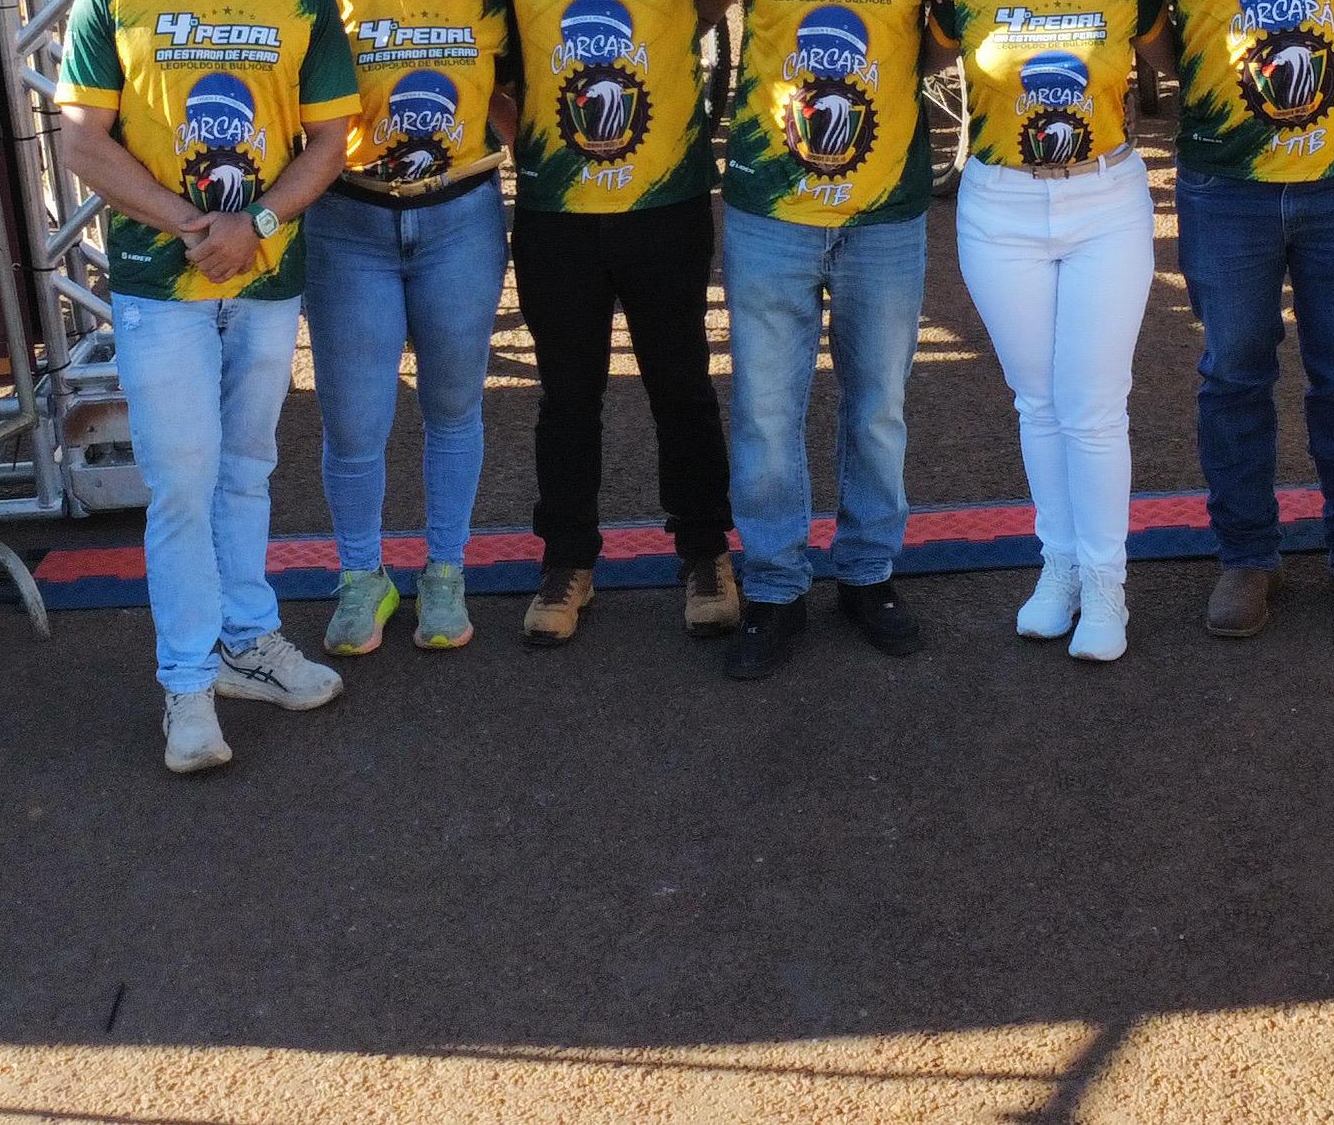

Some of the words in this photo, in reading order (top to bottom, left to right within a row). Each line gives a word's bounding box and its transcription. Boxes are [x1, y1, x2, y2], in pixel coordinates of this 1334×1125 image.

[1028, 14, 1107, 30] PEDAL
[195, 25, 281, 47] PEDAL
[395, 27, 475, 45] PEDAL
[161, 62, 214, 70] LEOPOLDO
[174, 50, 224, 60] ESTRADA
[225, 50, 239, 60] DE
[242, 51, 278, 62] FERRO
[363, 62, 415, 72] LEOPOLDO
[375, 50, 427, 61] ESTRADA
[429, 49, 442, 57] DE
[444, 48, 478, 57] FERRO
[551, 35, 648, 75] CARCARÁ
[783, 48, 879, 92] CARCARÁ
[1016, 87, 1093, 117] CARCARÁ
[175, 116, 266, 160] CARCARÁ
[373, 111, 465, 151] CARCARÁ
[1272, 128, 1326, 156] MTB
[581, 165, 634, 190] MTB
[798, 178, 853, 206] MTB
